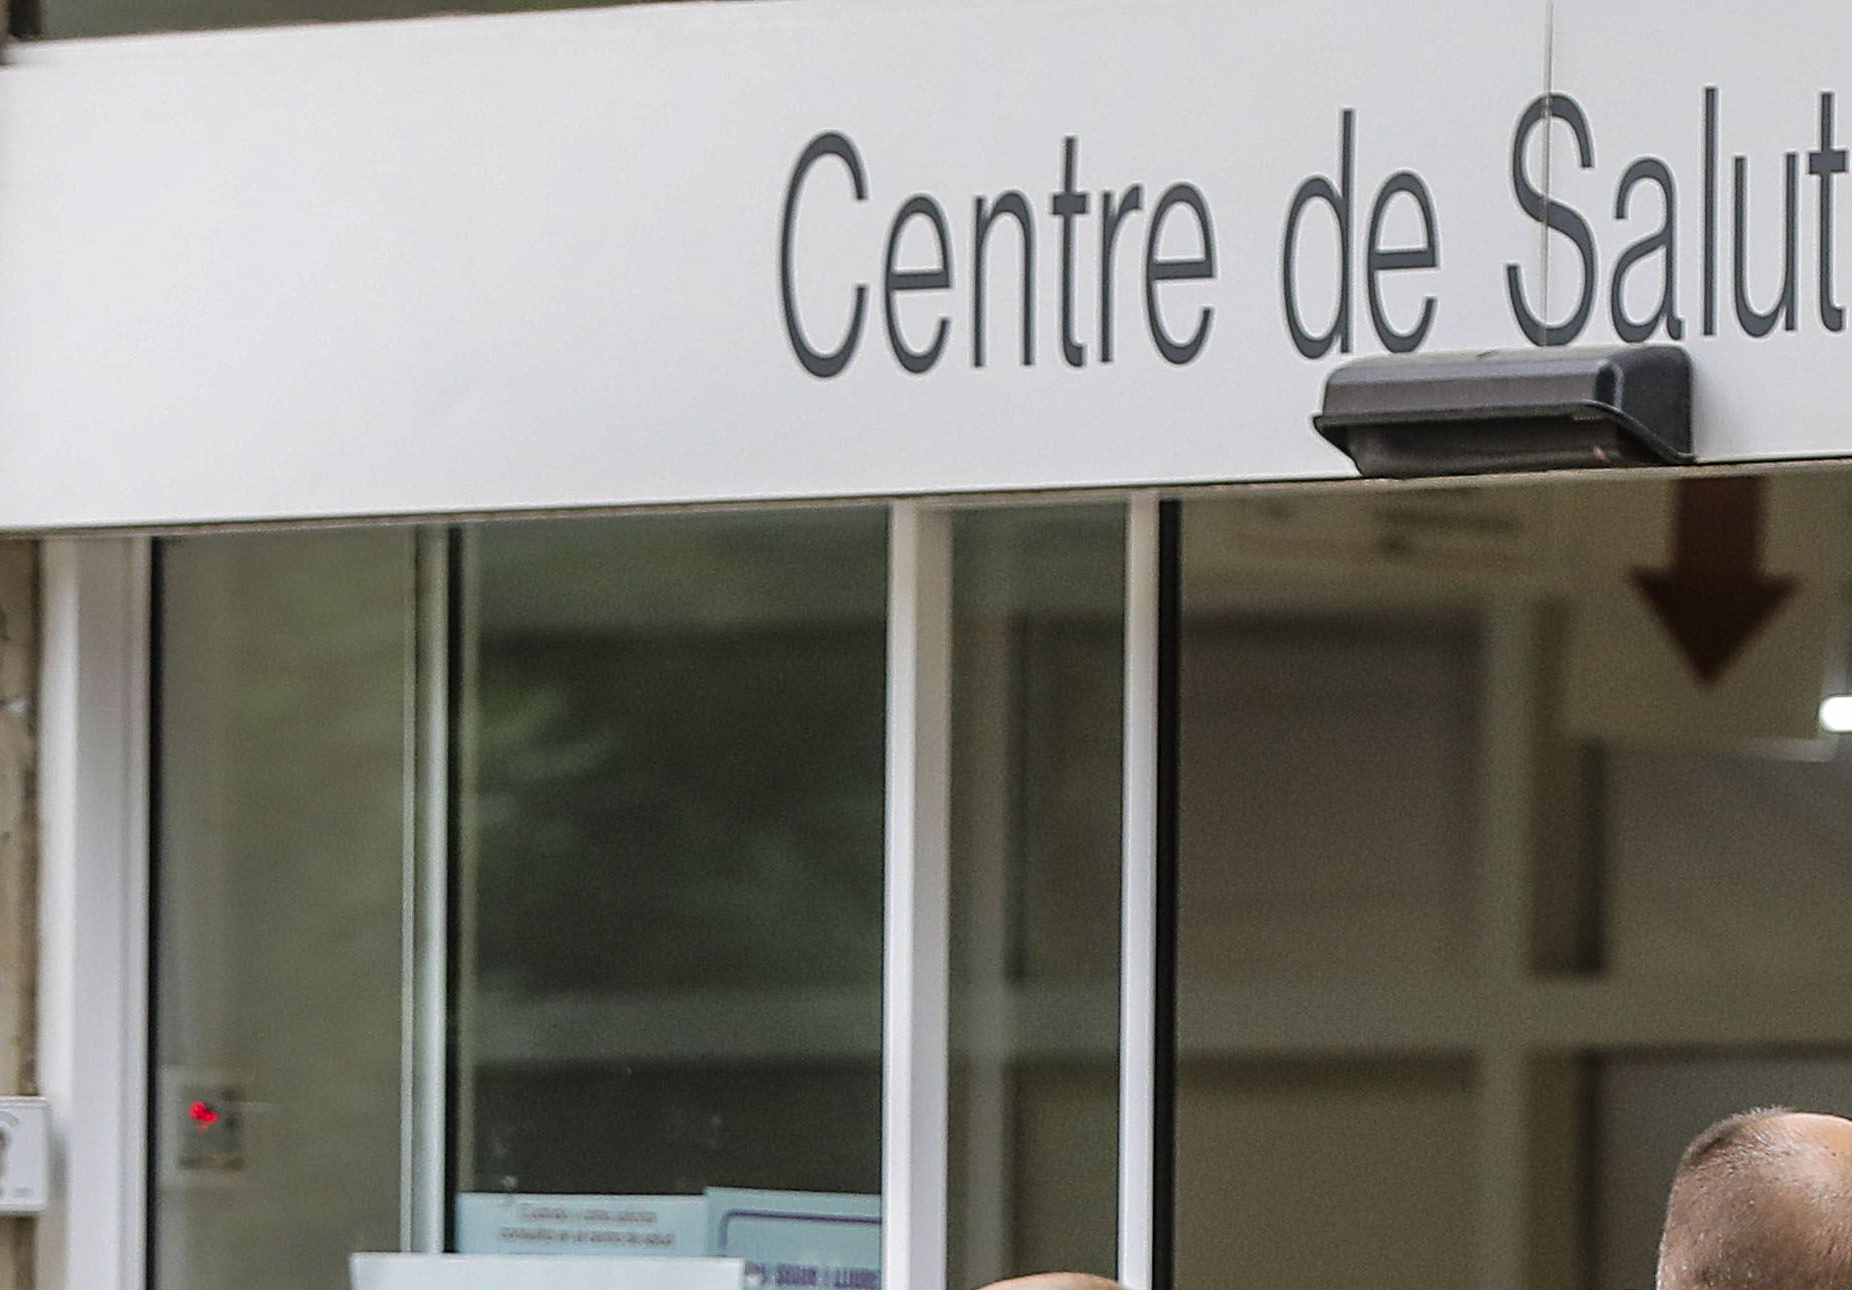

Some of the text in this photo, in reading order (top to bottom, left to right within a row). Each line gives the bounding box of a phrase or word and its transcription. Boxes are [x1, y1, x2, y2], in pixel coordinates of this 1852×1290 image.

[779, 130, 1219, 380] Centre
[1282, 109, 1442, 356] de
[1505, 86, 1849, 346] Salut
